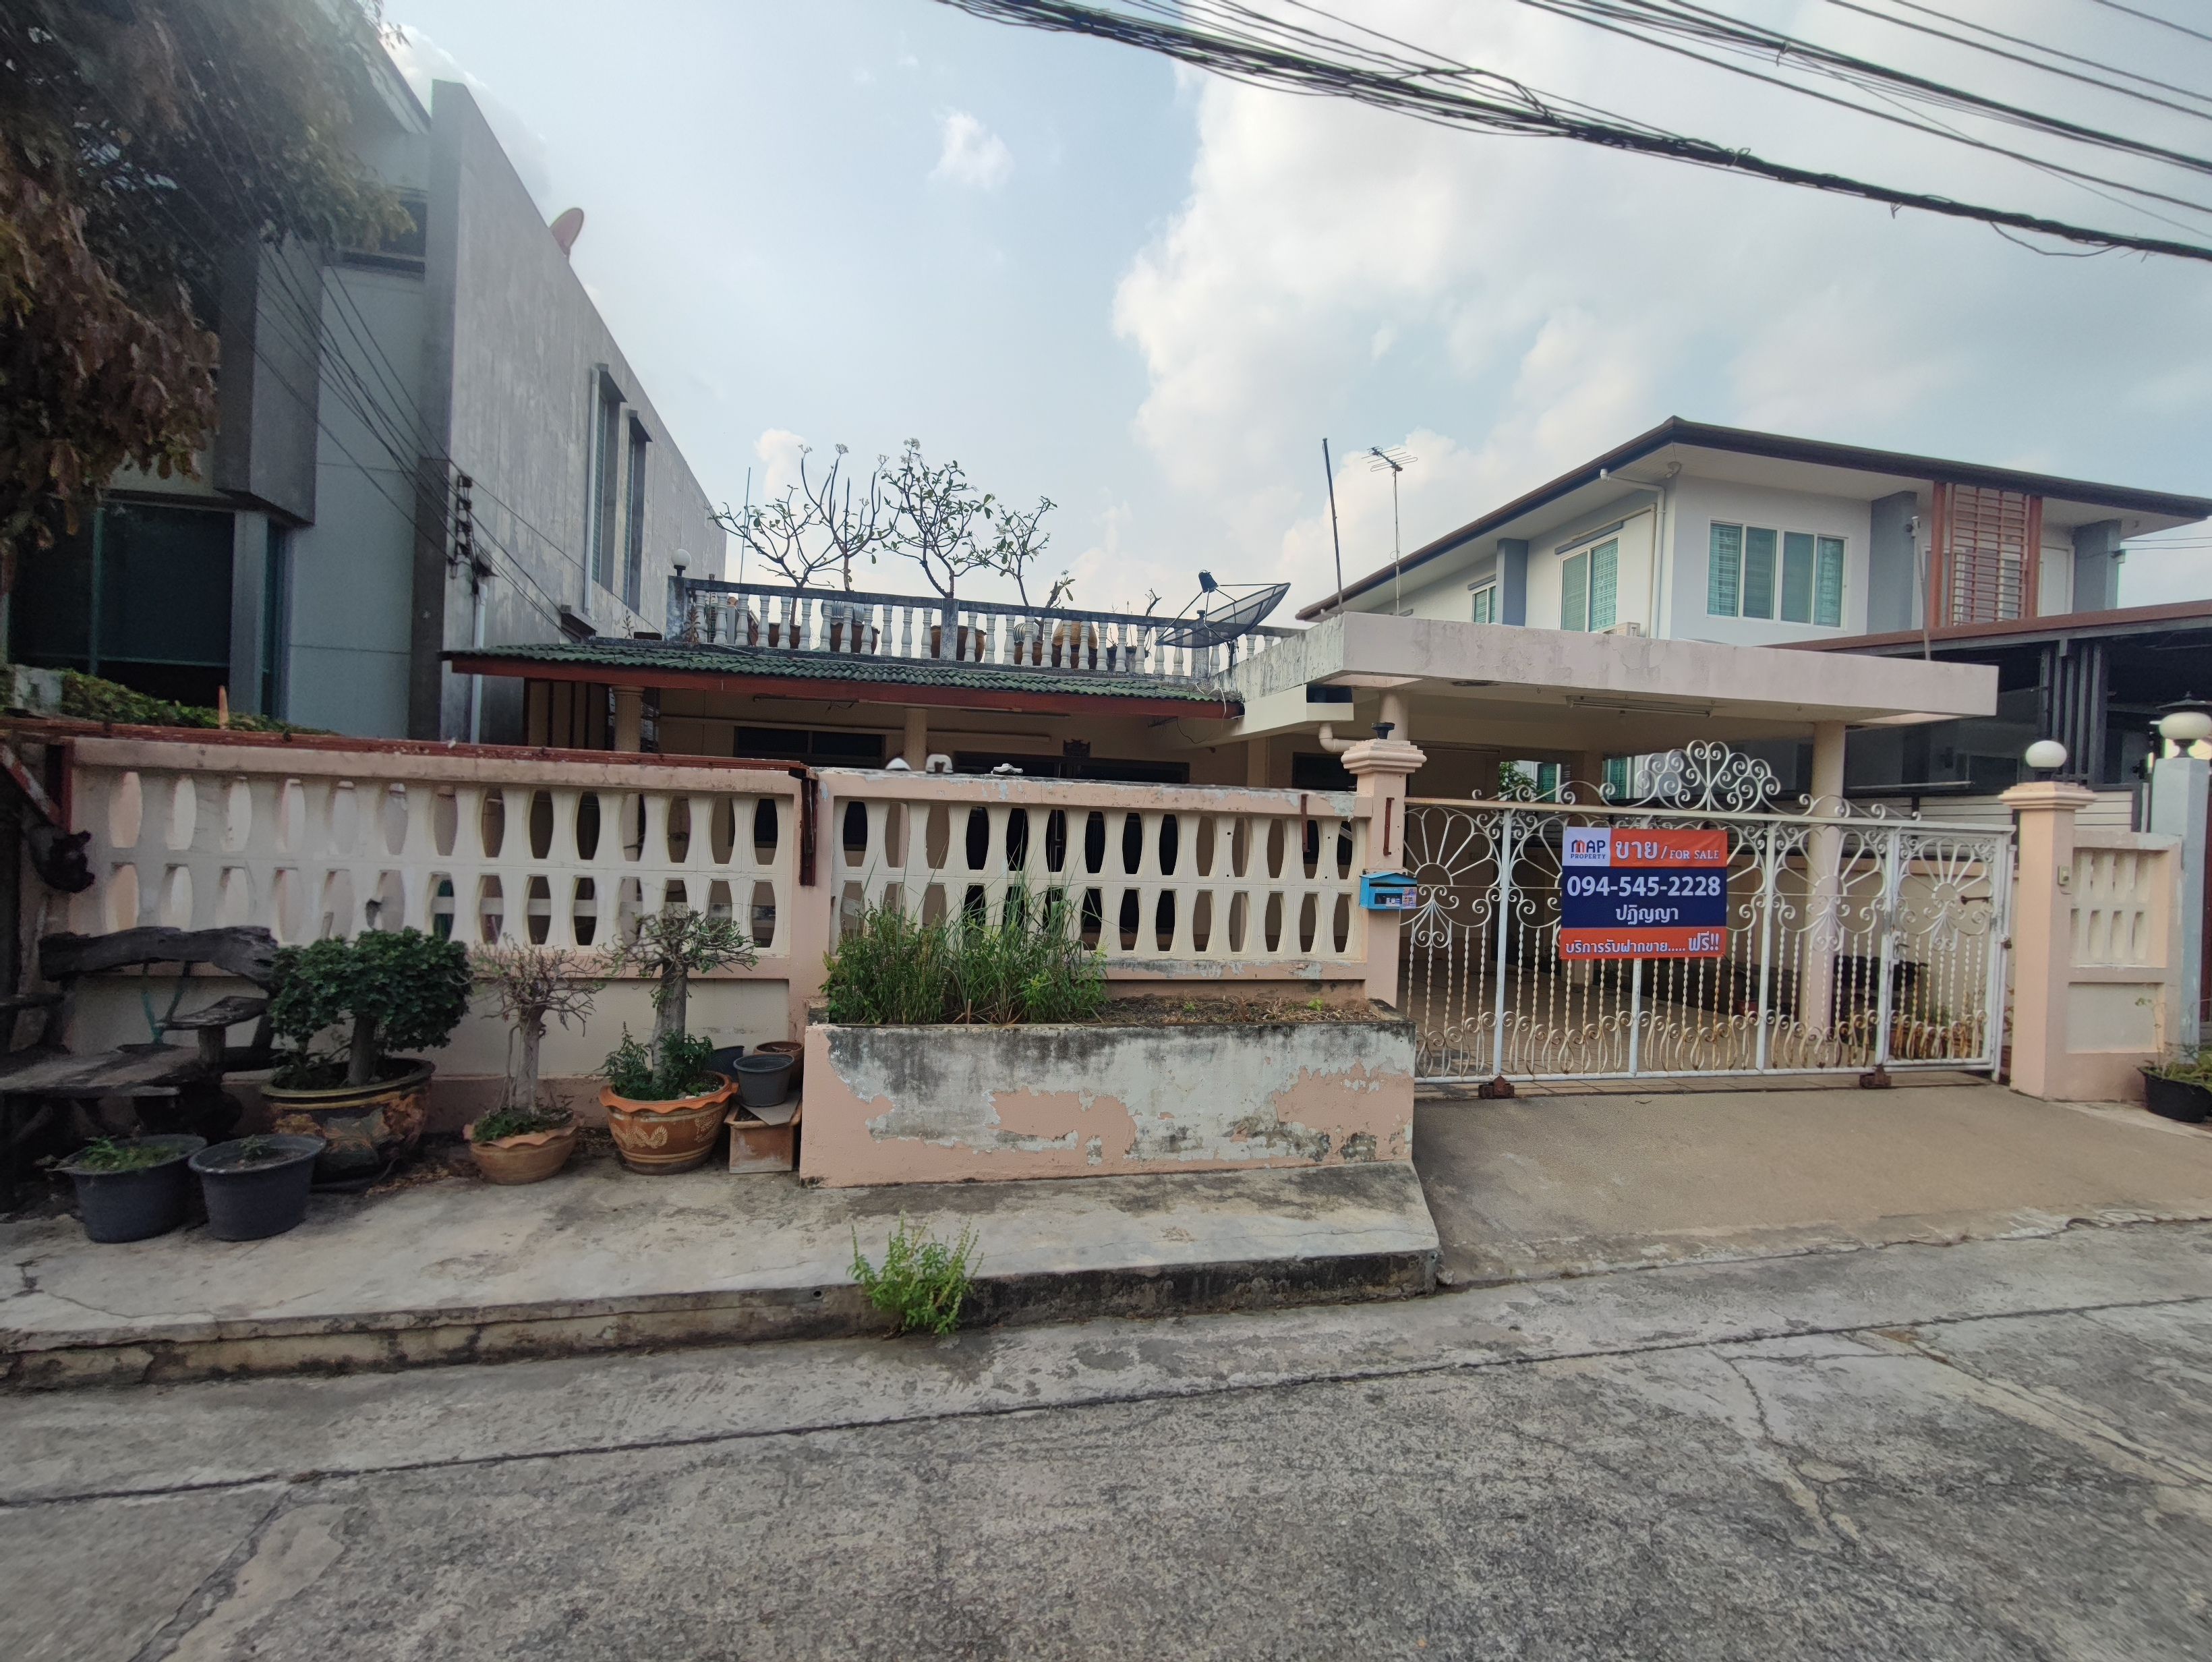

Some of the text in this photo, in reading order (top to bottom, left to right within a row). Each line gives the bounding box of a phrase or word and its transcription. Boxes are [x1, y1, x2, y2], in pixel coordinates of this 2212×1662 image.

[1571, 839, 1605, 853] MAP
[1616, 840, 1657, 859] ขาย
[1670, 851, 1689, 859] FOR
[1694, 850, 1719, 859] SALE
[1567, 876, 1720, 896] 094-545-2228
[1688, 931, 1719, 952] ฟรี!!
